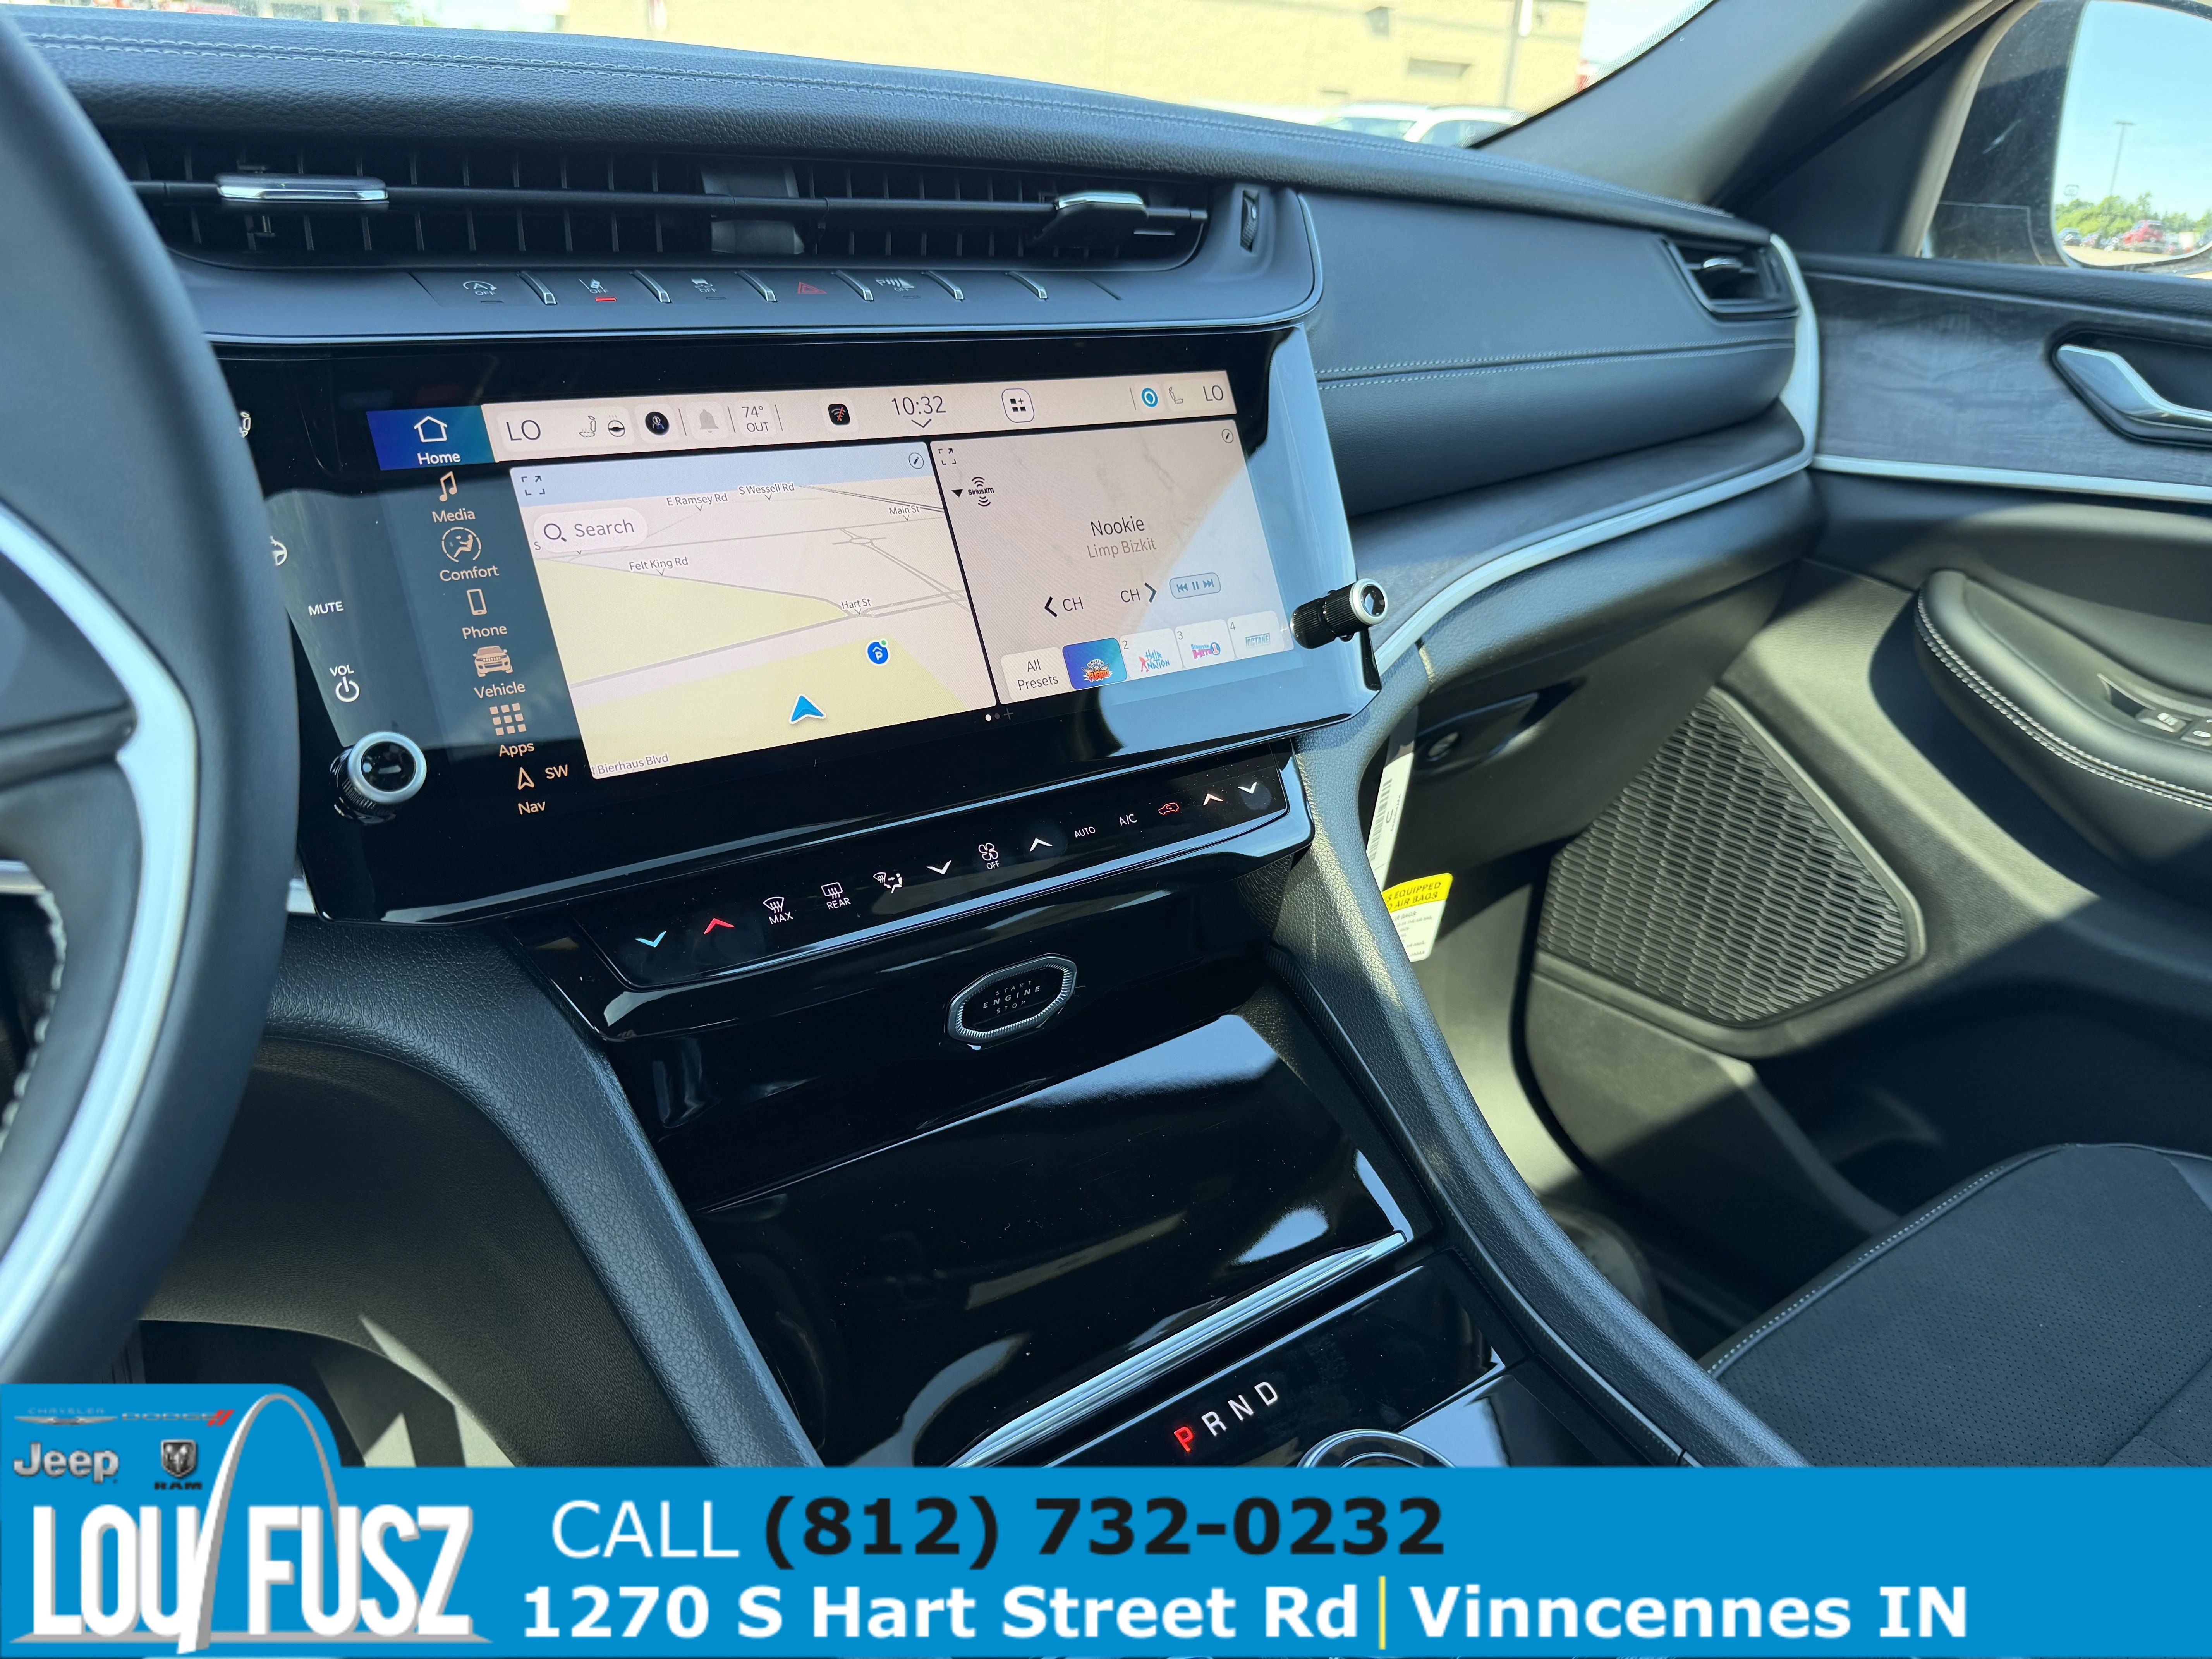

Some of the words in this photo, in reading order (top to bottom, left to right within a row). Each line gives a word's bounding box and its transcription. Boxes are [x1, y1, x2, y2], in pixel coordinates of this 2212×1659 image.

[1202, 385, 1224, 402] LO
[891, 395, 946, 416] 10:32
[506, 419, 541, 441] LO
[746, 422, 769, 433] OUT
[417, 452, 461, 465] Home
[738, 486, 744, 495] S
[744, 483, 780, 495] Wessell
[782, 482, 795, 492] Rd
[666, 497, 672, 507] E
[675, 495, 713, 507] Ramsey
[714, 493, 728, 503] Rd
[432, 508, 476, 523] Media
[889, 506, 908, 515] Main
[909, 505, 920, 514] St
[574, 519, 635, 538] Search
[1090, 516, 1145, 536] Nookie
[1087, 542, 1119, 558] Limp
[1121, 537, 1157, 554] Bizkit
[629, 560, 648, 571] Felt
[649, 558, 673, 570] King
[675, 557, 688, 567] Rd
[440, 565, 500, 582] Comfort
[841, 599, 860, 610] Hart
[862, 598, 871, 607] St
[1120, 589, 1141, 604] CH
[308, 601, 344, 616] MUTE
[1062, 597, 1084, 612] CH
[462, 624, 508, 639] Phone
[1230, 622, 1236, 630] 4
[1177, 631, 1183, 640] 3
[1122, 640, 1129, 649] 2
[329, 664, 354, 677] VOL
[1027, 659, 1041, 672] All
[1147, 659, 1170, 670] NATION
[1017, 673, 1058, 690] Presets
[474, 682, 526, 699] Vehicle
[499, 742, 535, 758] Apps
[598, 759, 644, 774] Bierhaus
[646, 753, 669, 766] Blvd
[545, 765, 569, 780] SW
[518, 801, 546, 815] Nav
[1119, 814, 1137, 827] A/C
[1074, 826, 1096, 838] AUTO
[986, 860, 1000, 870] OFF
[1394, 882, 1441, 899] EQUIPPED
[826, 897, 851, 910] REAR
[1395, 898, 1410, 908] AIR
[1413, 891, 1438, 903] BAGS
[769, 911, 793, 925] MAX
[995, 981, 1032, 996] START
[983, 986, 1041, 1009] ENGINE
[996, 1000, 1026, 1014] STOP
